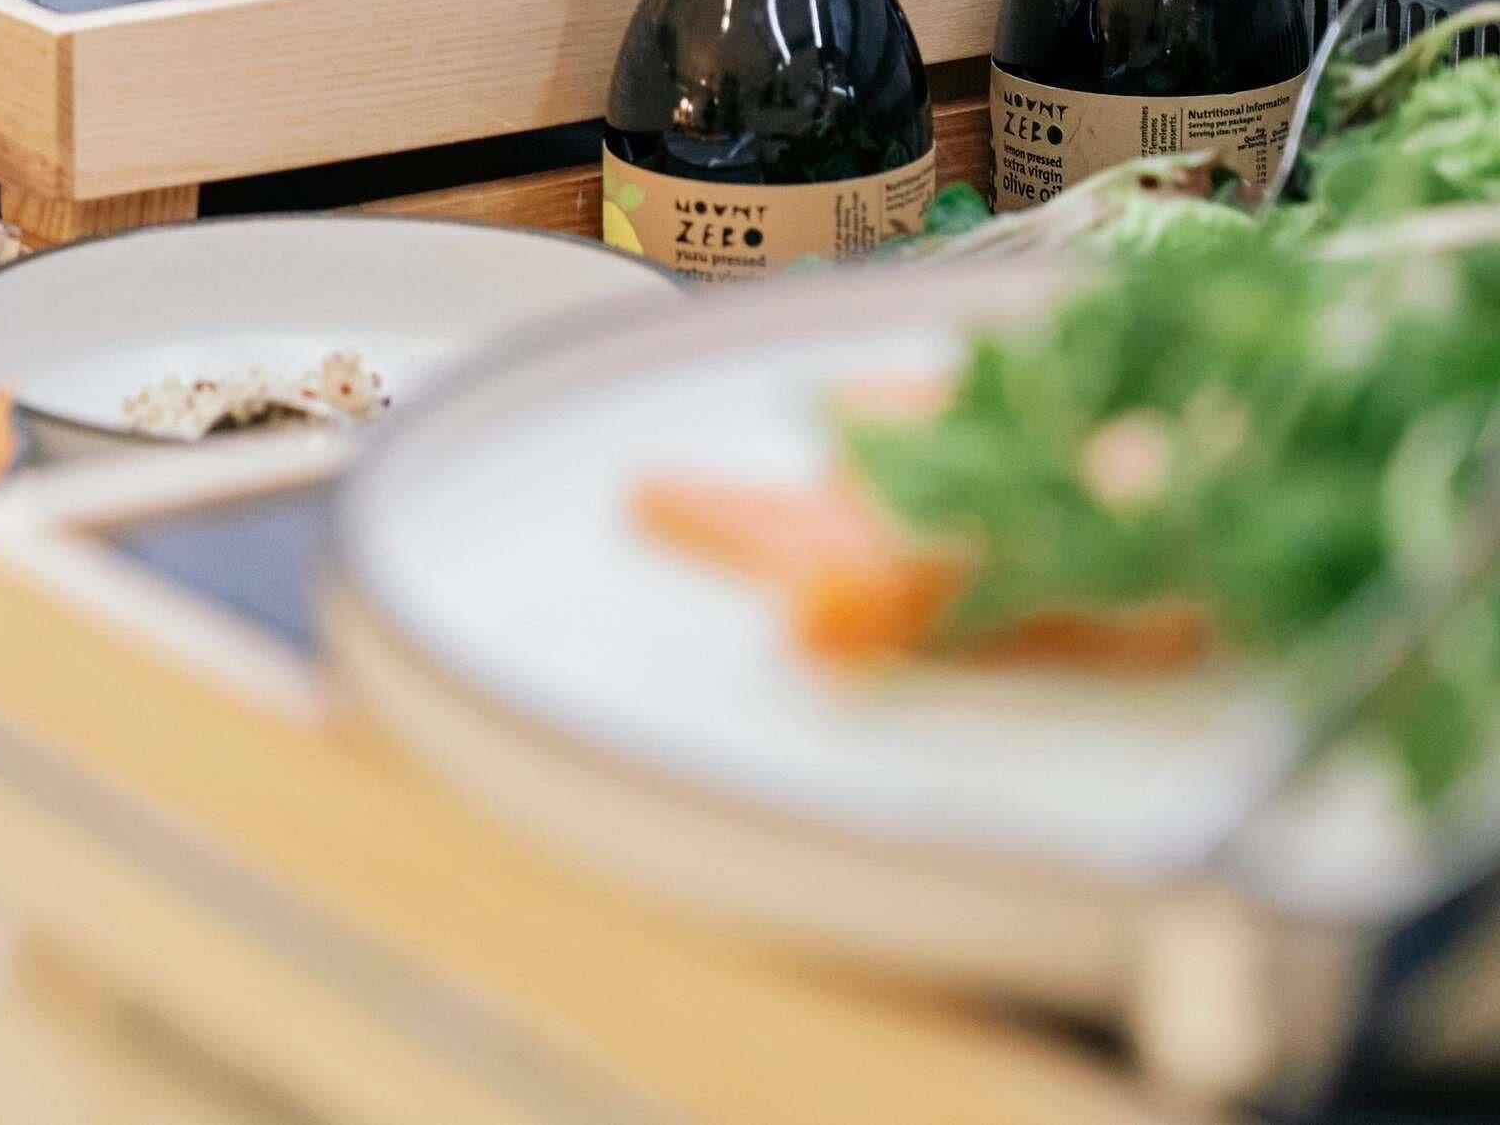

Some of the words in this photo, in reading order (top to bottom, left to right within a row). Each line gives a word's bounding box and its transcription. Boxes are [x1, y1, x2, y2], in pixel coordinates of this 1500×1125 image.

[1188, 104, 1244, 119] Nutritional
[1246, 96, 1290, 113] Information
[1004, 111, 1063, 145] ZERO
[1004, 141, 1026, 158] lemon
[1027, 152, 1062, 168] pressed
[1004, 157, 1026, 174] extra
[1027, 165, 1062, 184] virgin
[1003, 174, 1035, 200] olive
[676, 220, 763, 247] ZERO
[712, 254, 766, 268] pressed
